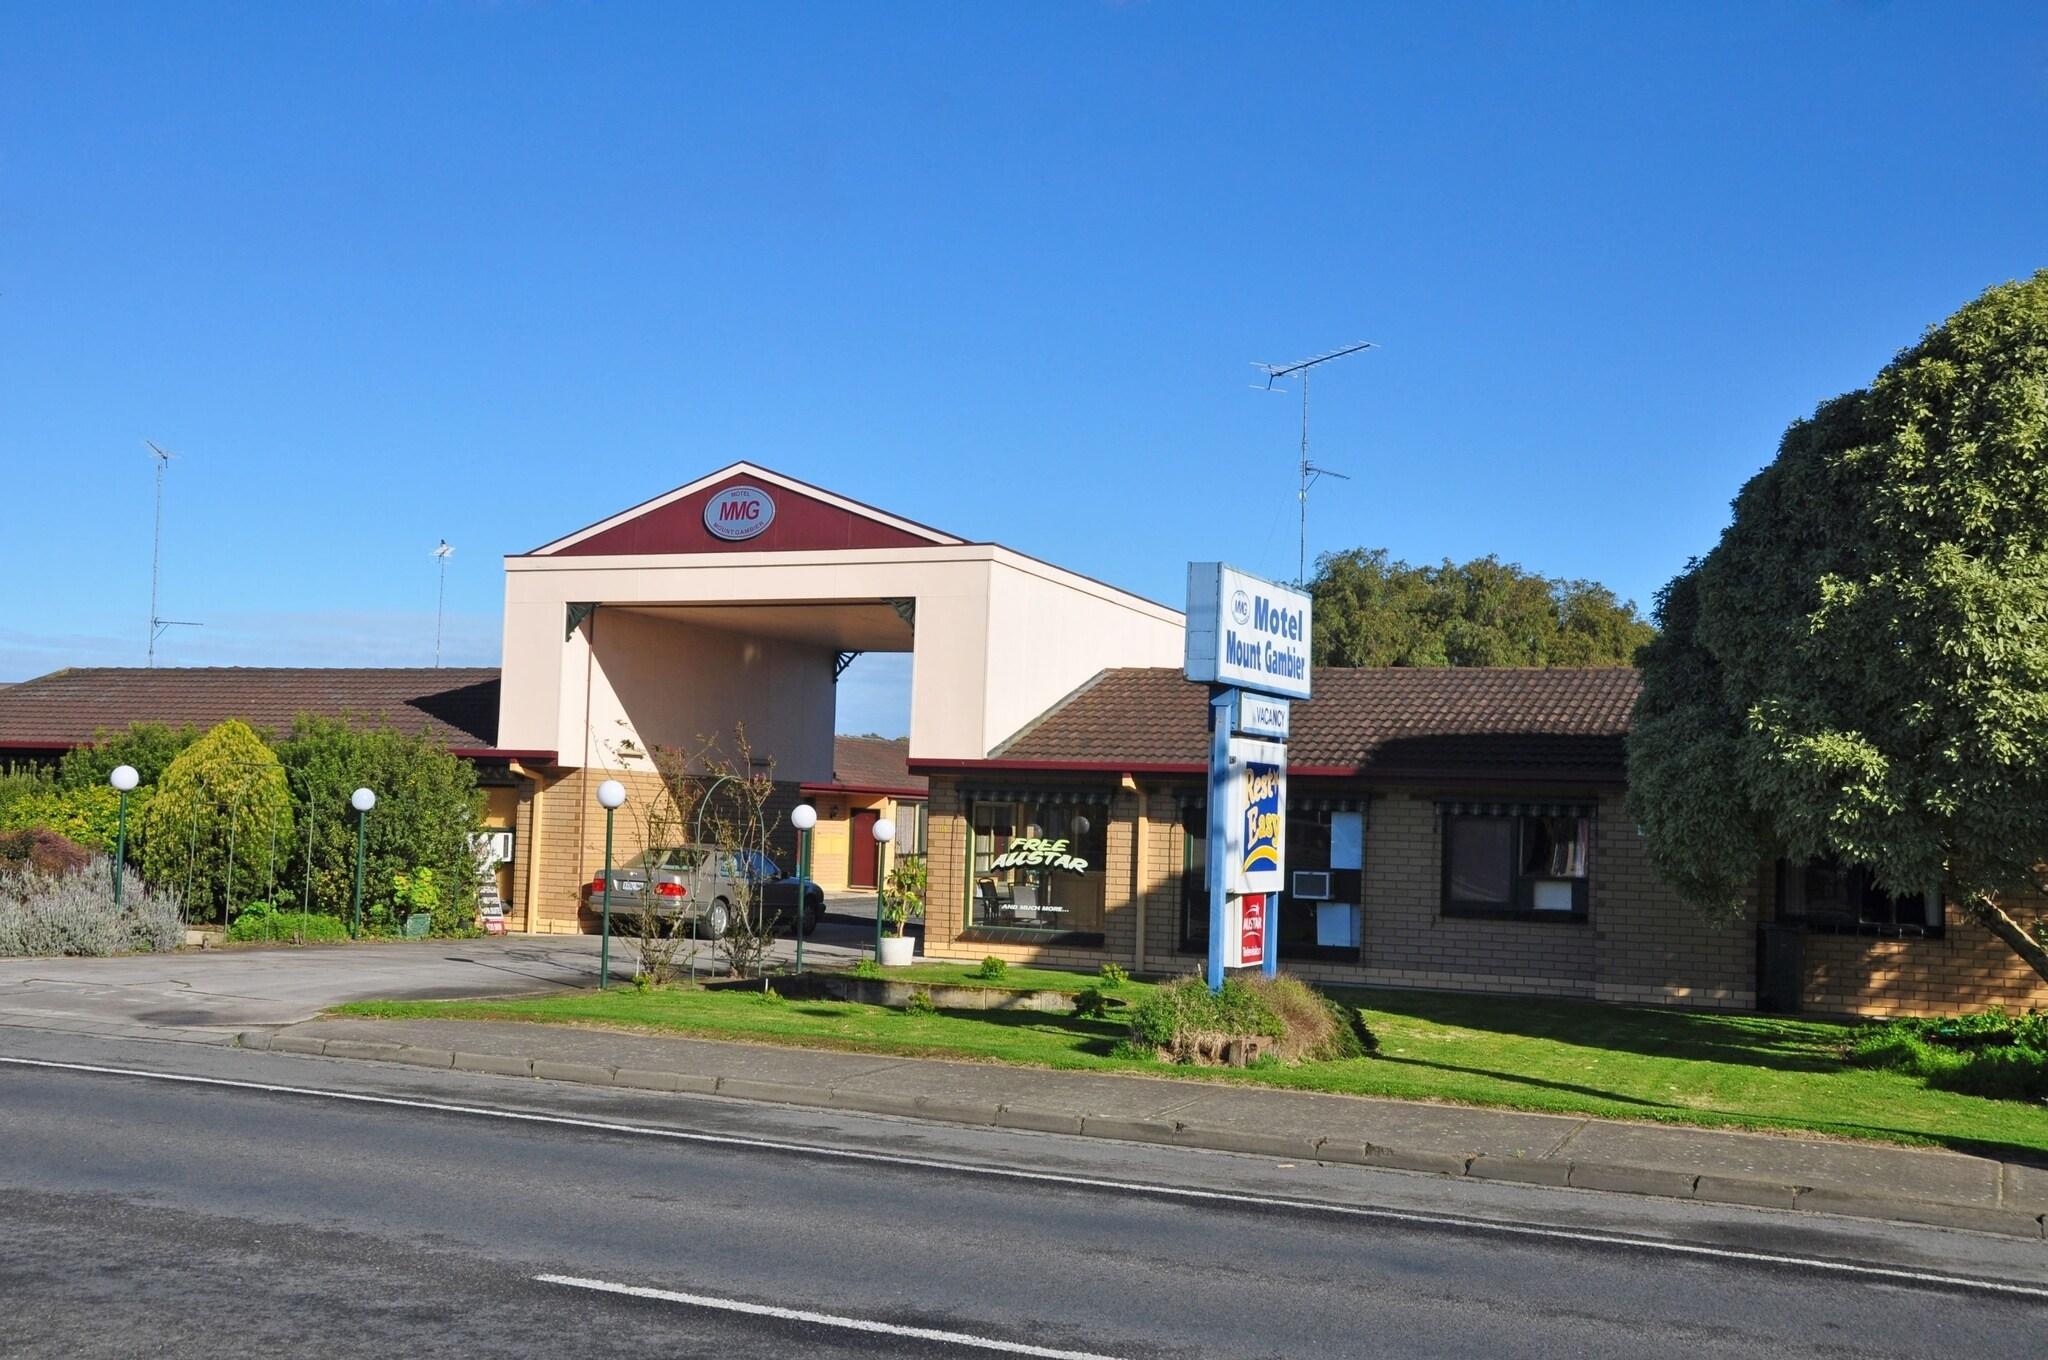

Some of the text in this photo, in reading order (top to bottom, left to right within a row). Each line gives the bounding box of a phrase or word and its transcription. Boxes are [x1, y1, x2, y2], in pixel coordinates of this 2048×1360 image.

[719, 500, 760, 521] MMG
[713, 521, 764, 535] MOUNT GAMBIER
[1234, 599, 1248, 616] MMG
[1254, 595, 1303, 642] Motel
[1226, 629, 1305, 680] Mount Gambier
[1256, 706, 1285, 728] VACANCY
[1247, 805, 1280, 850] Easy
[1010, 837, 1070, 852] FREE
[990, 850, 1089, 874] AUSTAR
[1243, 917, 1262, 930] AUSTAR
